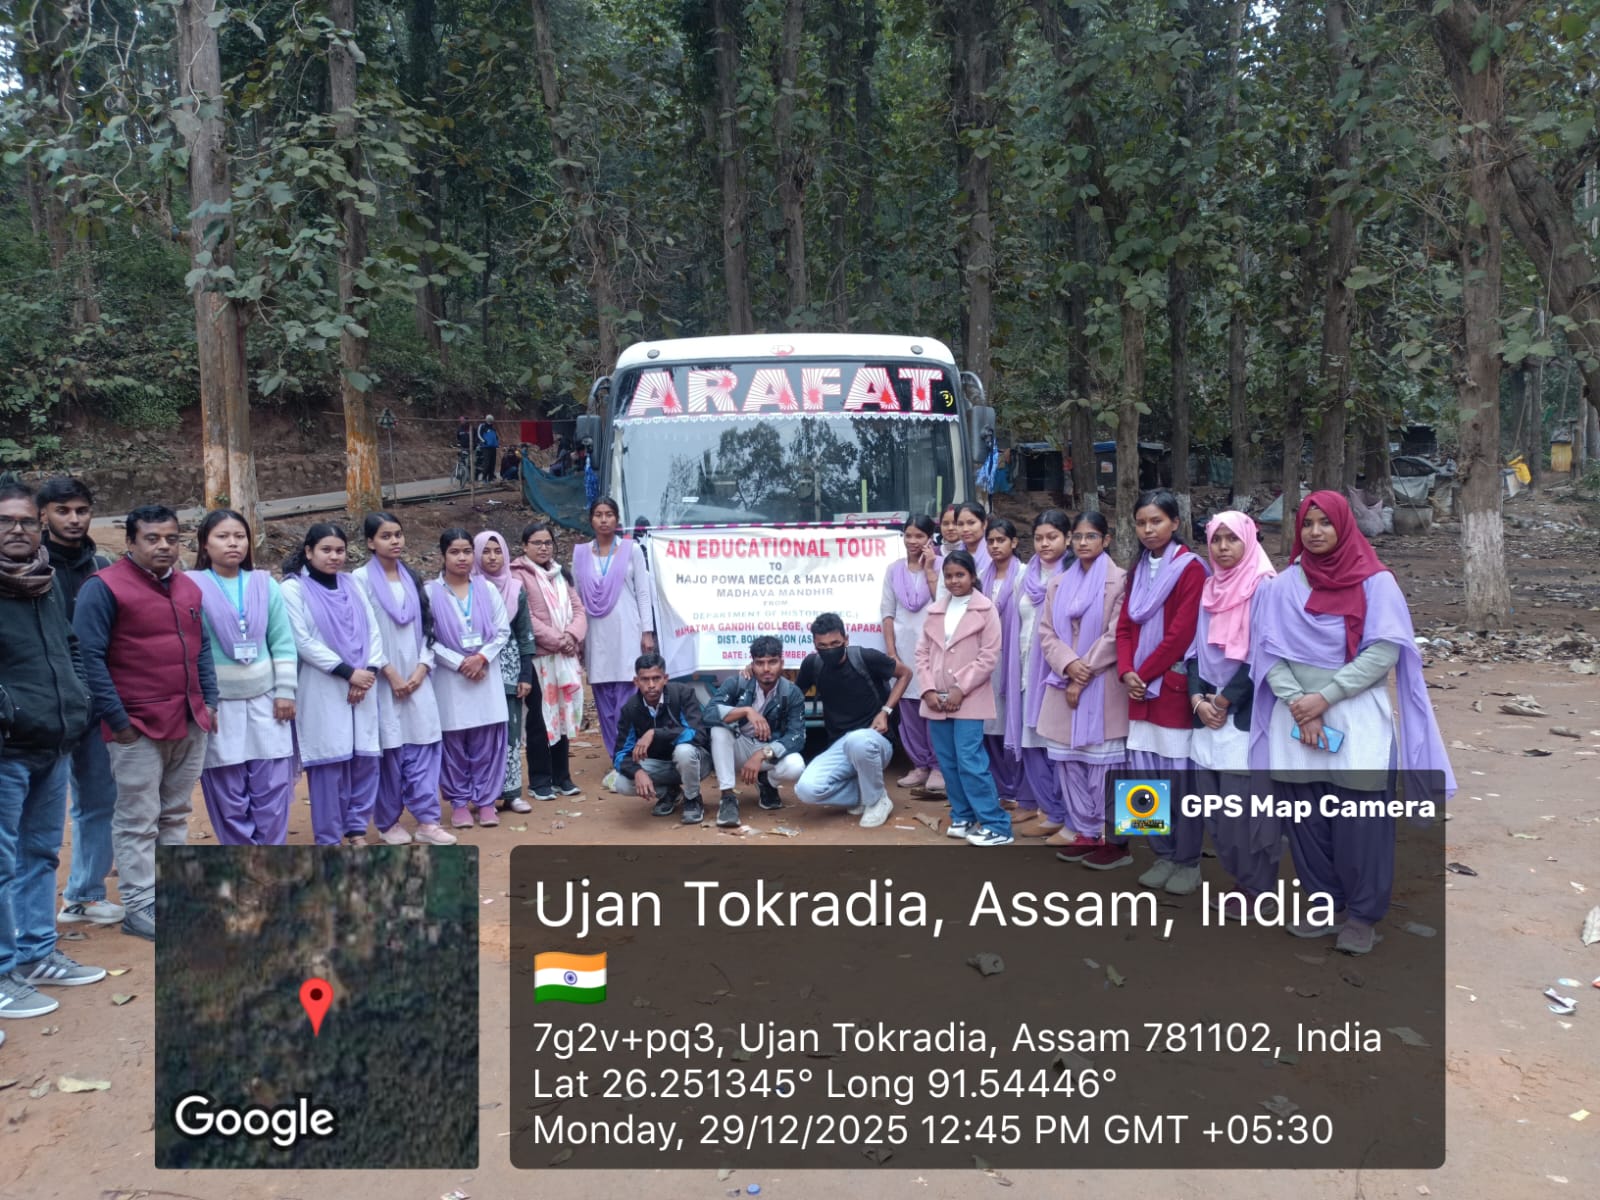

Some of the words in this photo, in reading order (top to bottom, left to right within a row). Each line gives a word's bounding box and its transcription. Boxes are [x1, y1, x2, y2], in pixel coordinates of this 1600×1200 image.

[628, 367, 944, 417] ARAFAT
[666, 540, 691, 558] AN
[697, 538, 830, 558] EDUCATIONAL
[835, 537, 886, 557] TOUR
[769, 562, 782, 571] TO
[676, 574, 707, 585] HAJO
[711, 574, 745, 585] POWA
[749, 574, 790, 585] MECCA
[793, 574, 800, 584] &
[805, 573, 875, 585] HAYAGRIVA
[716, 588, 774, 598] MADHAVA
[778, 587, 834, 597] MANDHIR
[693, 610, 761, 620] DEPARTMENT
[718, 622, 755, 631] GANDHI
[758, 621, 804, 632] COLLEGE,
[717, 634, 739, 644] DIST.
[722, 651, 743, 659] DATE
